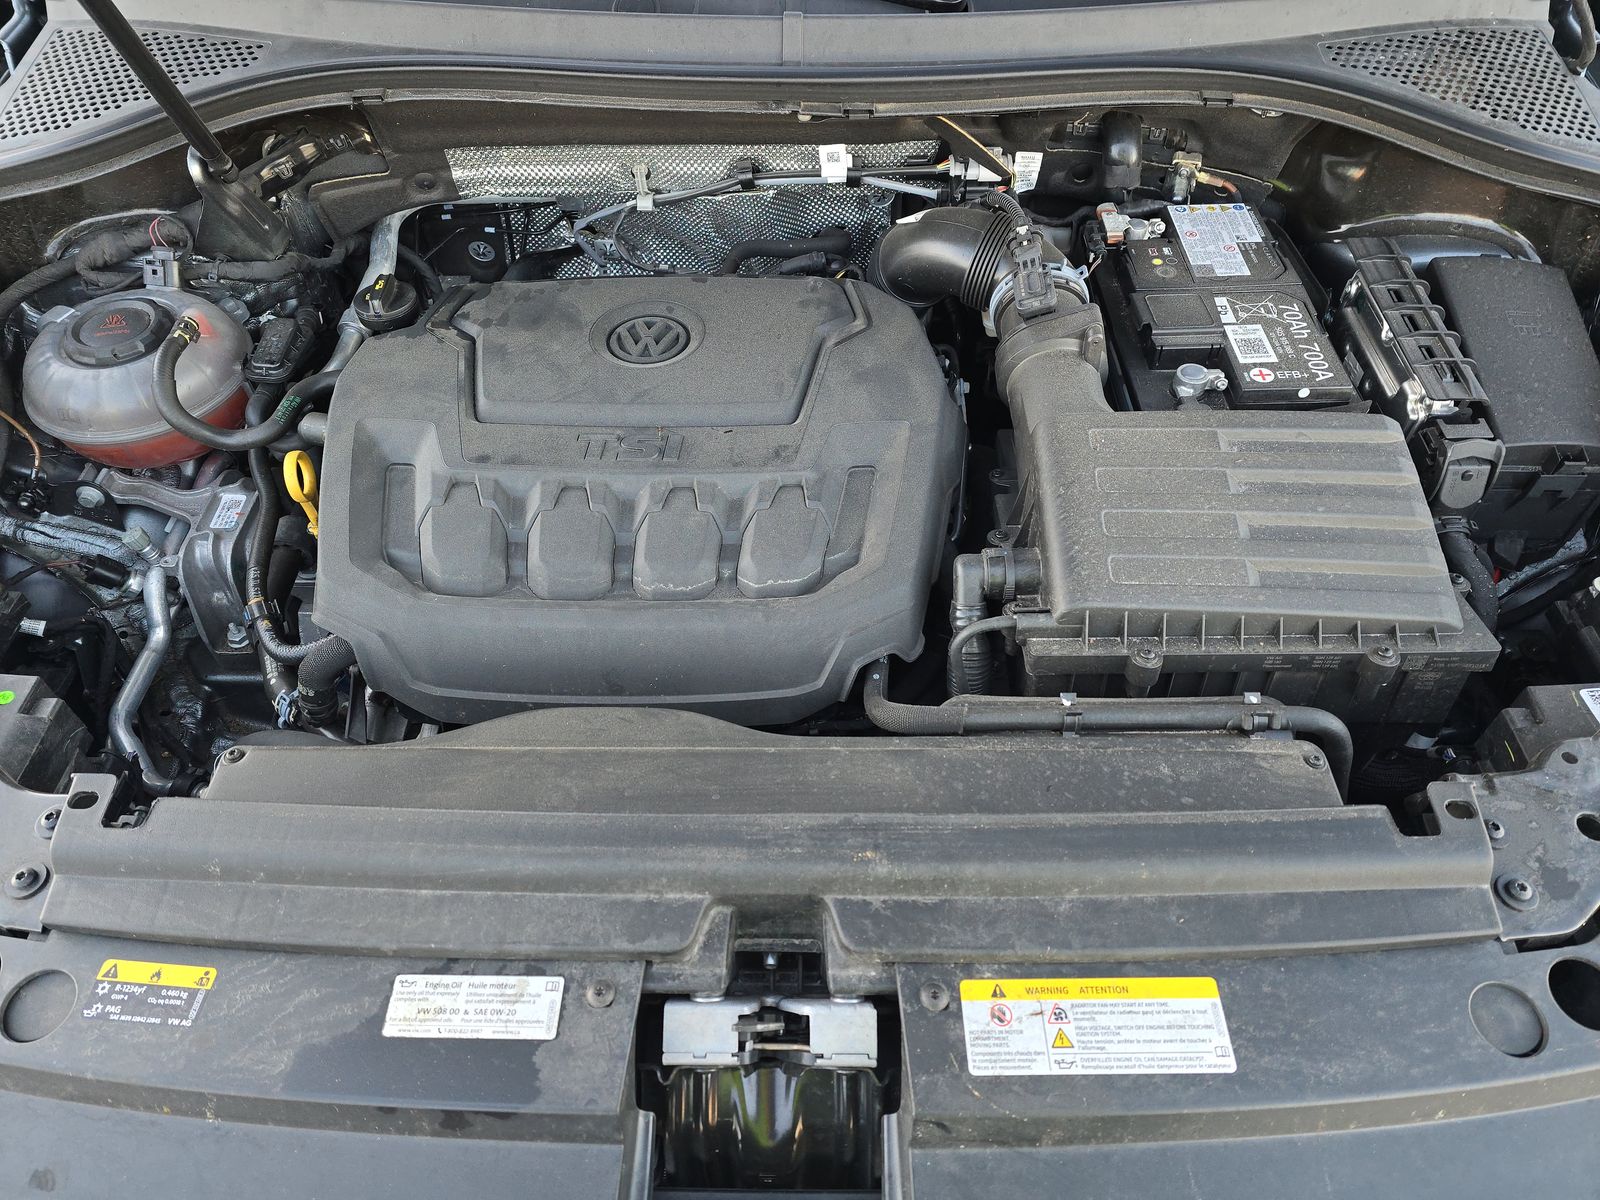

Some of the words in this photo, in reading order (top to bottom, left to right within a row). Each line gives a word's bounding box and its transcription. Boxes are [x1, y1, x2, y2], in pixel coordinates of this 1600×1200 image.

[1262, 246, 1278, 267] CLARIOS
[1217, 304, 1228, 316] Pb
[1279, 303, 1311, 339] 70Ah
[1298, 342, 1335, 382] 700A
[1276, 370, 1310, 379] EFB+
[577, 433, 685, 461] TSI
[424, 980, 450, 990] Engine
[451, 981, 463, 989] Oil
[468, 981, 488, 989] Huile
[1025, 986, 1069, 995] WARNING
[1079, 985, 1129, 994] ATTENTION
[114, 984, 147, 995] R-1234yf
[161, 989, 179, 997] 0.460
[180, 990, 189, 999] kg
[105, 1005, 121, 1014] PAG
[417, 1007, 431, 1015] VW
[432, 1007, 448, 1015] 508
[473, 1008, 488, 1016] SAE
[489, 1008, 517, 1016] 0W-20
[167, 1018, 181, 1026] VW
[181, 1019, 192, 1027] AG
